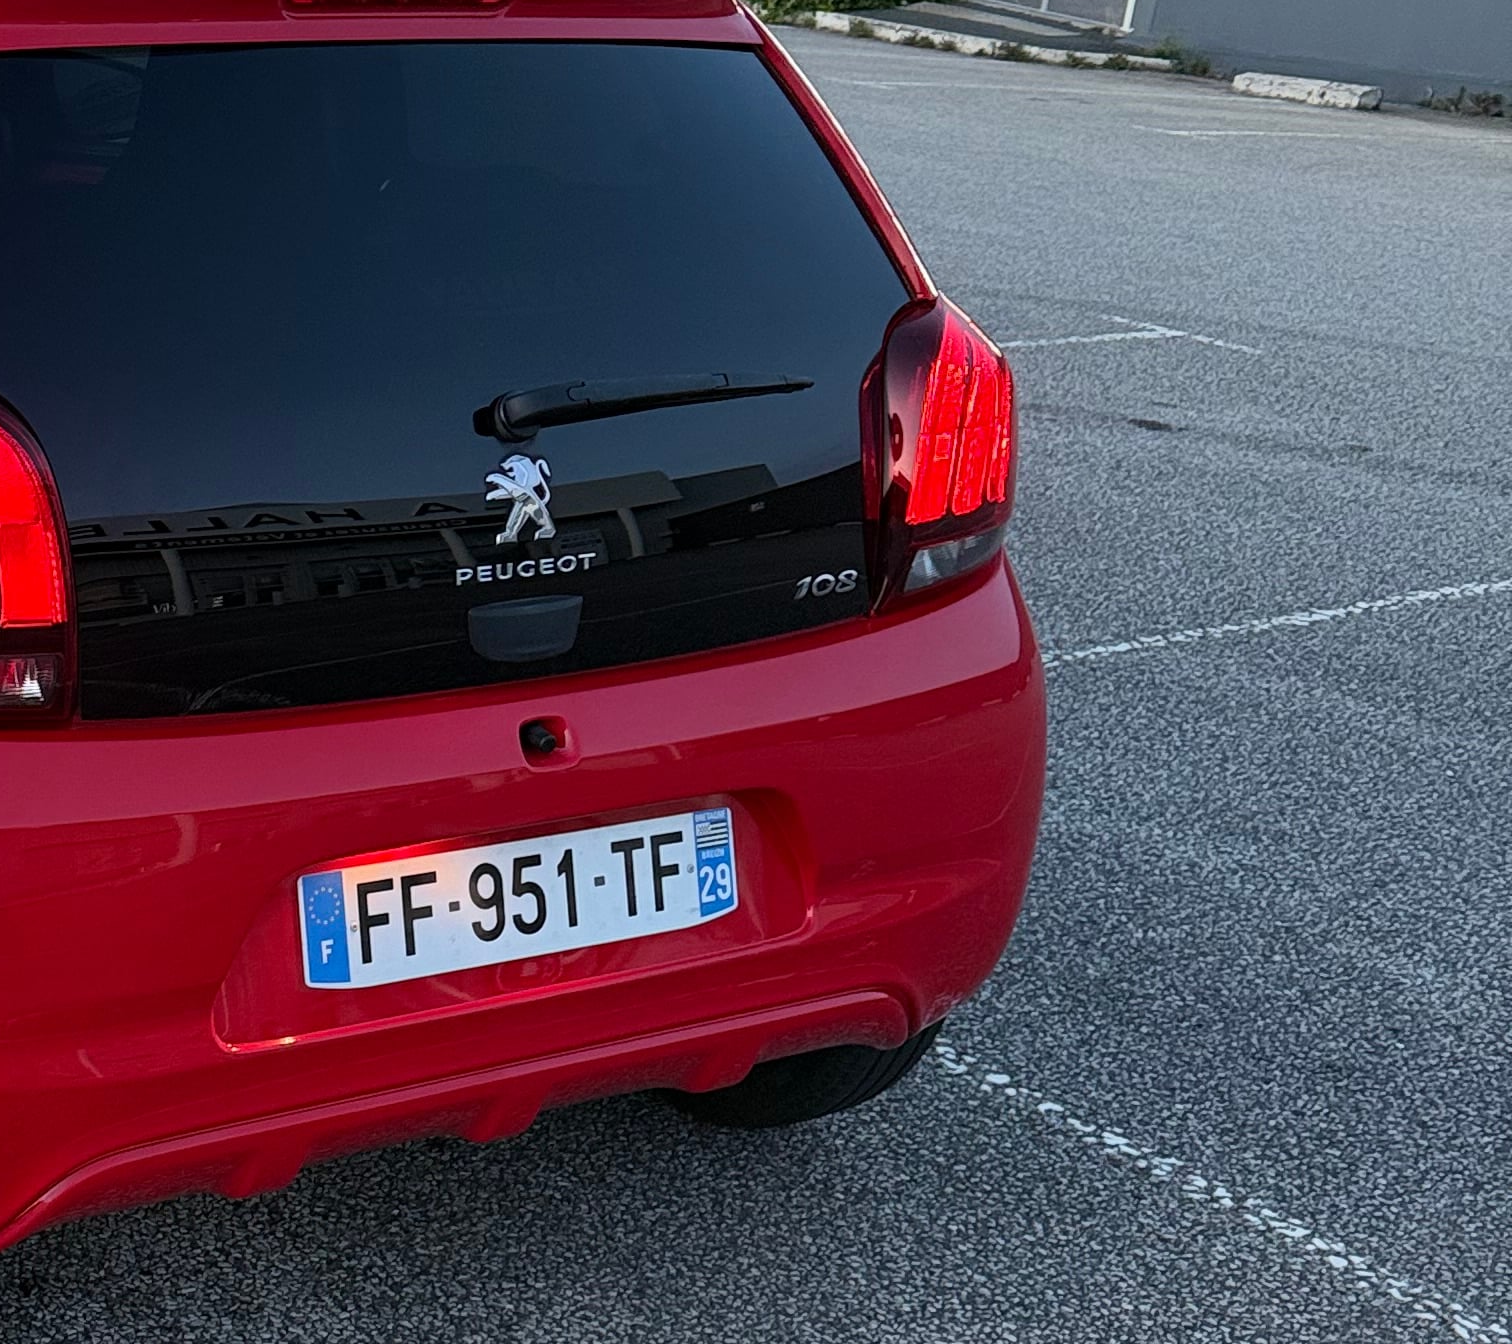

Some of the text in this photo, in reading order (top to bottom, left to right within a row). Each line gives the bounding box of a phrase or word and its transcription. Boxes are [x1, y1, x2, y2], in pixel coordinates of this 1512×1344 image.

[455, 552, 597, 587] PEUGEOT
[793, 569, 859, 601] 108
[320, 830, 732, 965] F FF-951-TF 29
